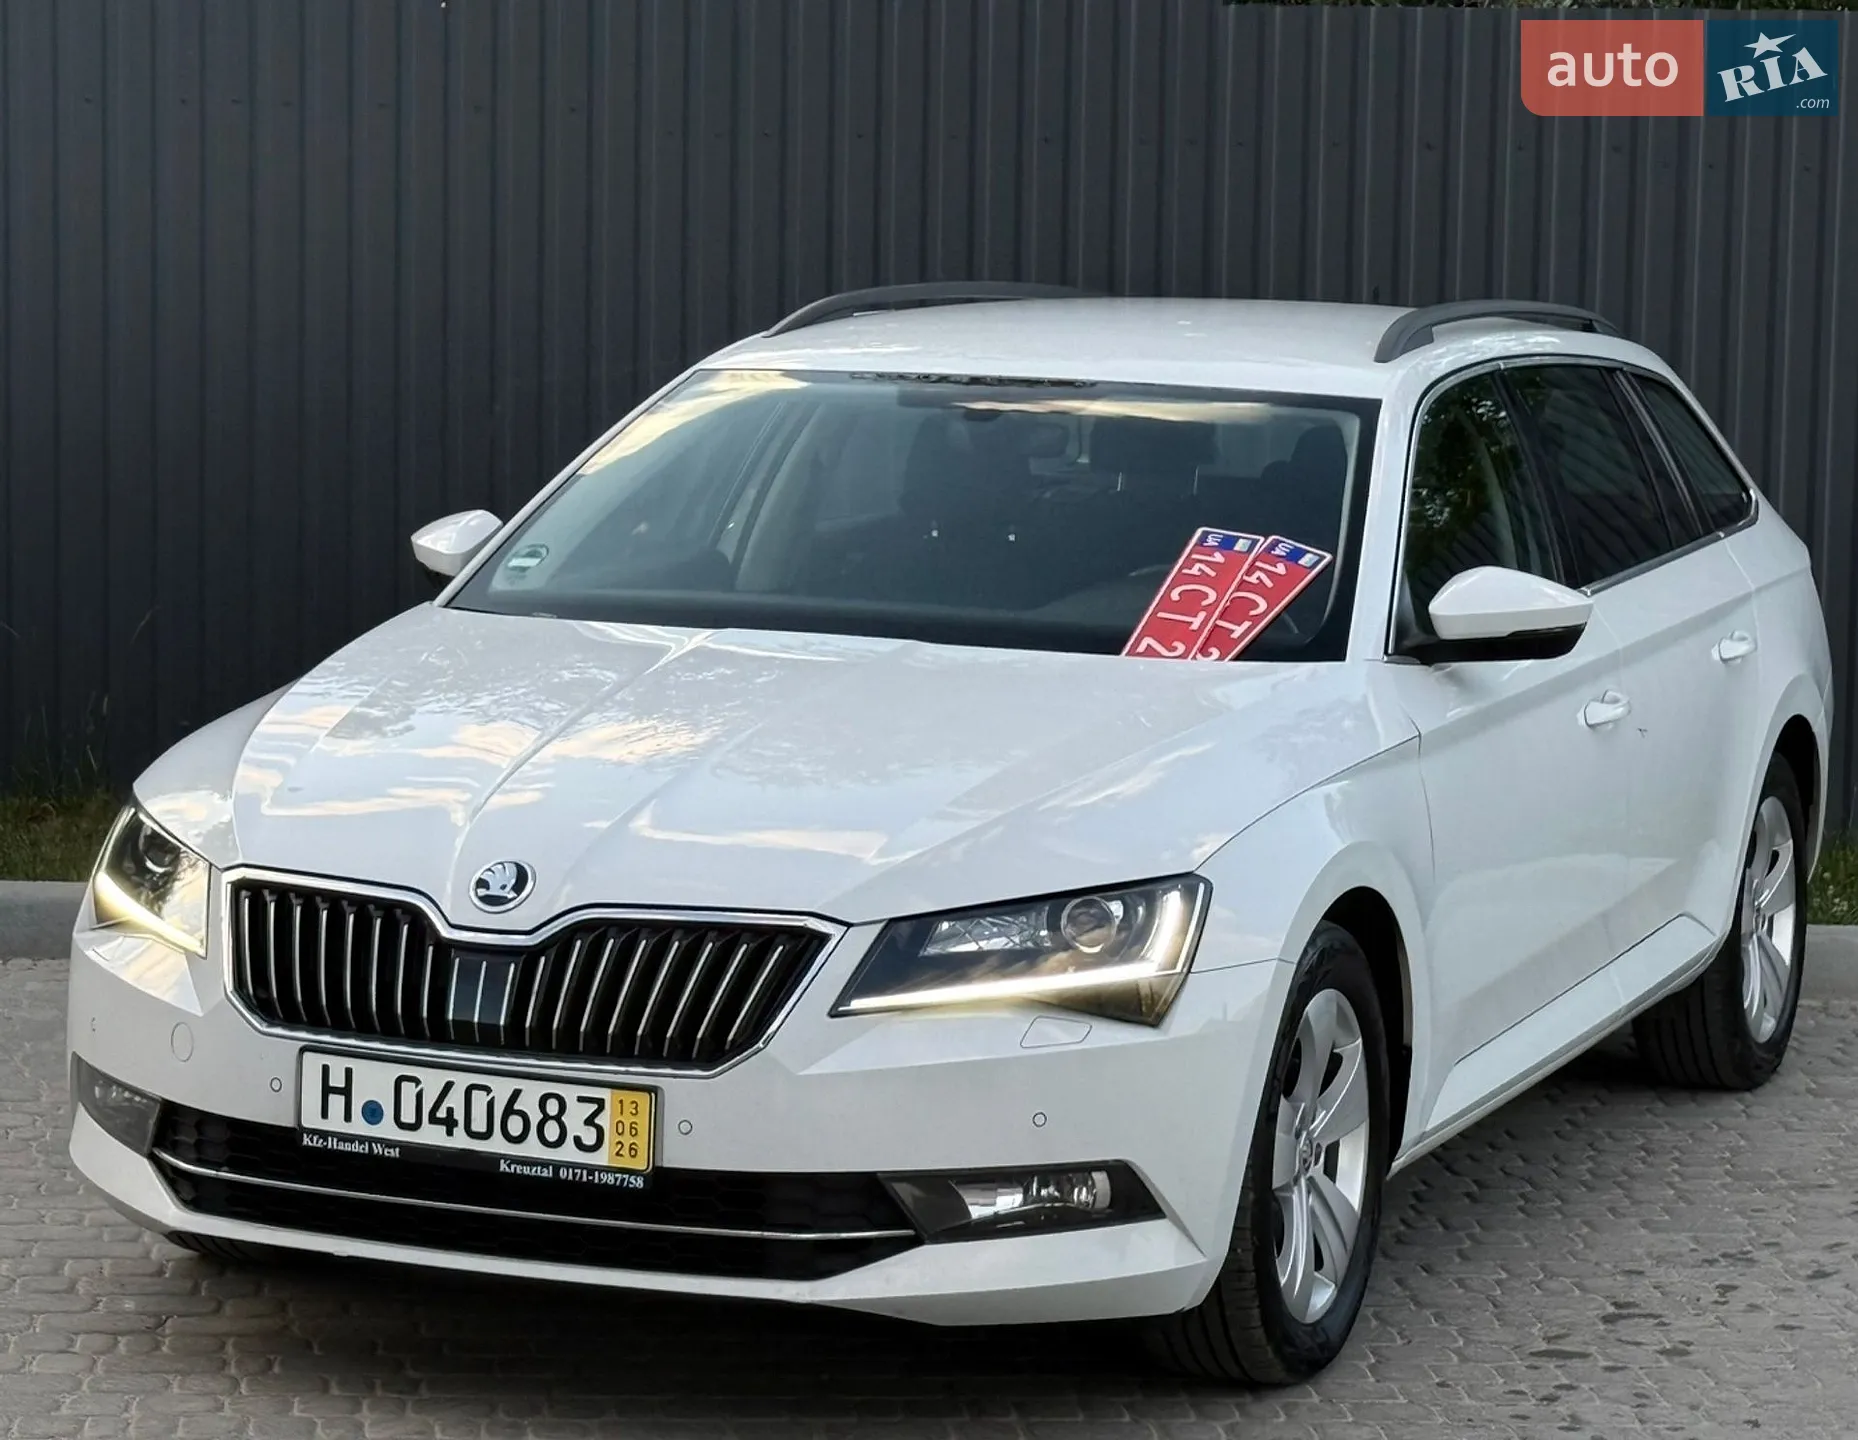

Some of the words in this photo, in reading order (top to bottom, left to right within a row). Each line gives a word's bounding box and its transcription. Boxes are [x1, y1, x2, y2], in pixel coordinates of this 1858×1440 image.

[321, 1063, 353, 1123] H
[618, 1099, 639, 1117] 13
[615, 1120, 639, 1137] 06
[302, 1133, 369, 1153] Kfz-Handel
[372, 1142, 400, 1158] West
[615, 1141, 638, 1158] 26
[500, 1159, 553, 1177] Kreuztal
[559, 1168, 644, 1189] 0171-1987758
